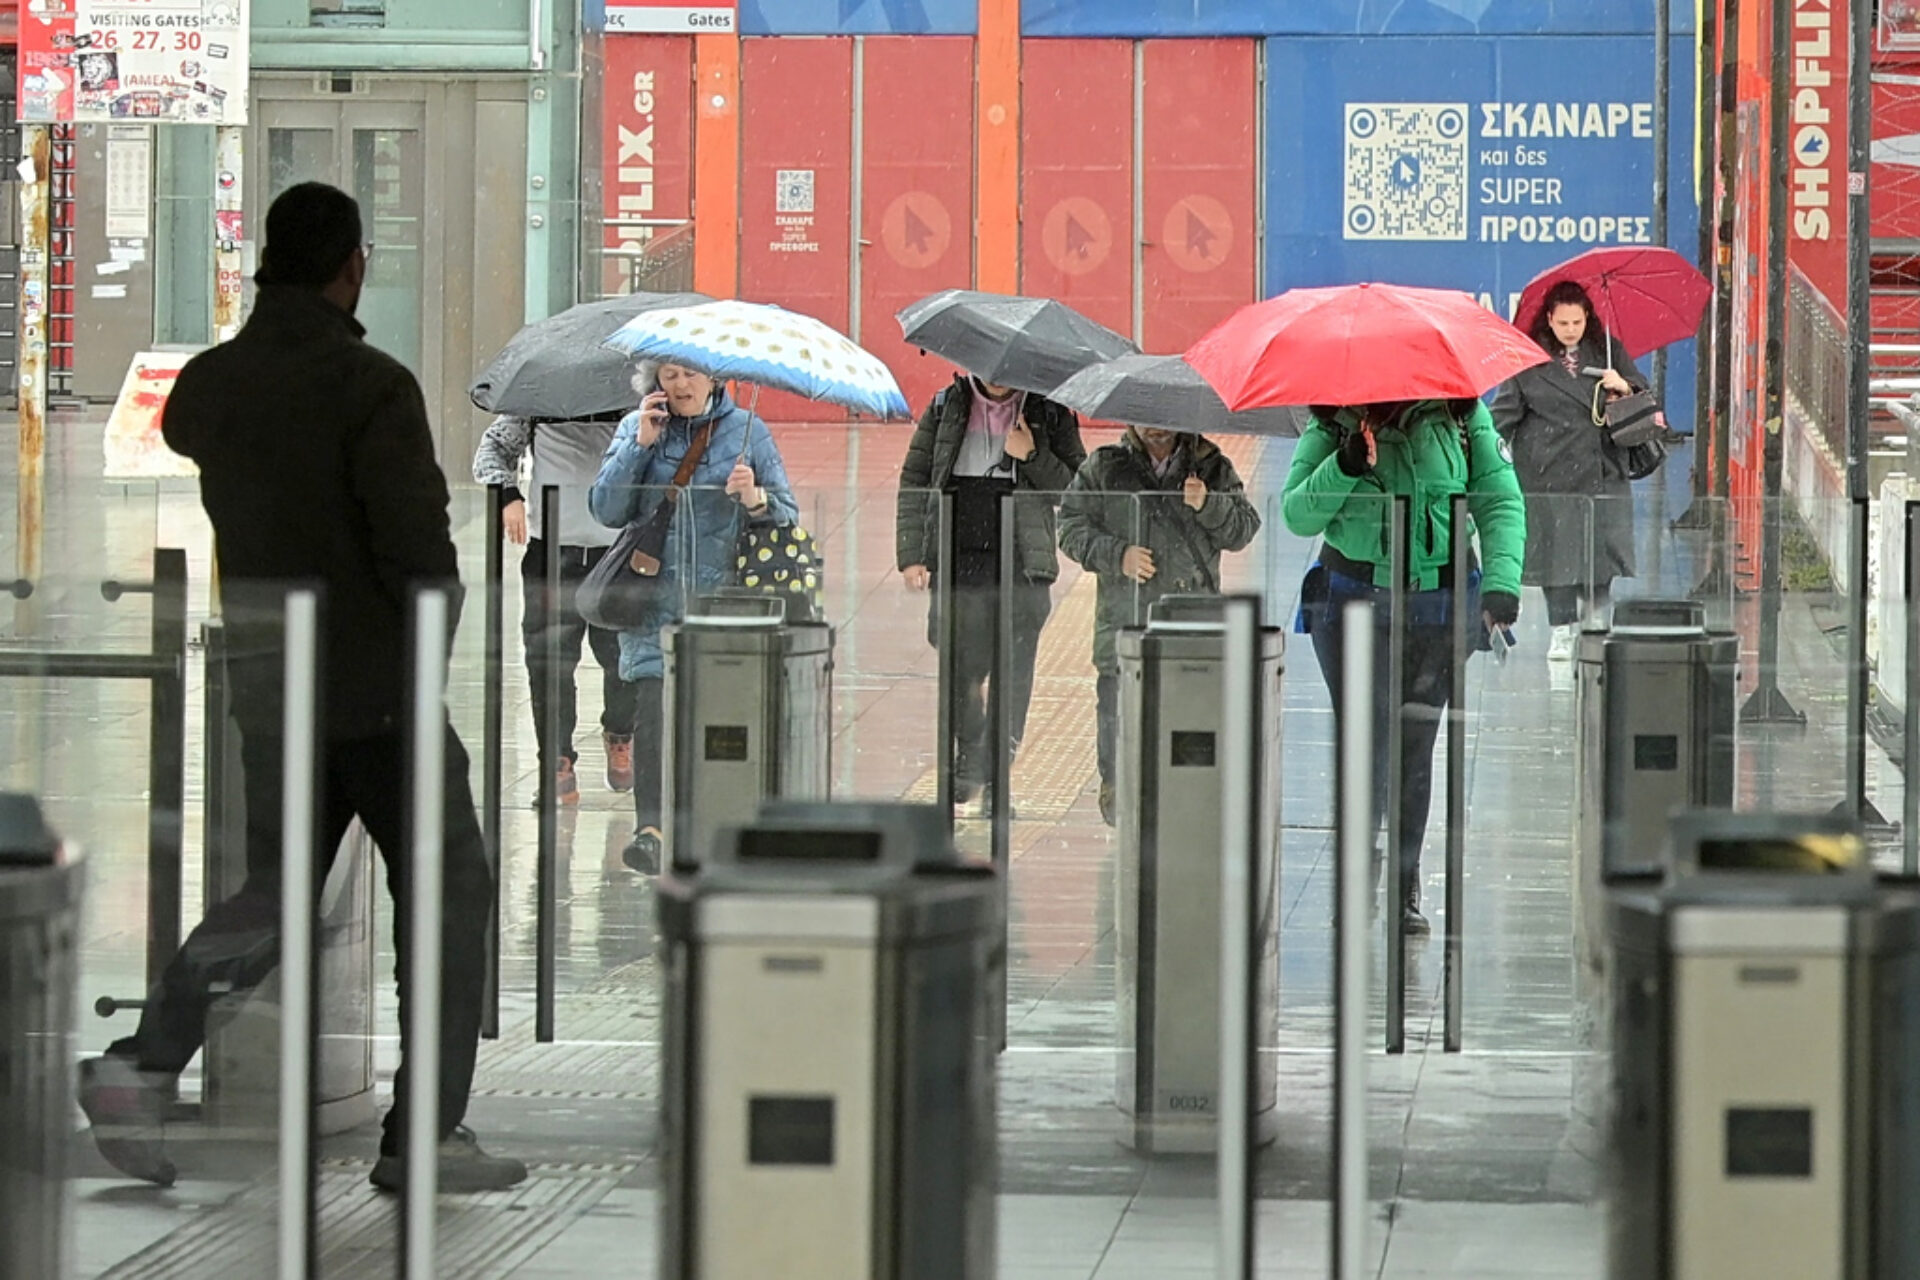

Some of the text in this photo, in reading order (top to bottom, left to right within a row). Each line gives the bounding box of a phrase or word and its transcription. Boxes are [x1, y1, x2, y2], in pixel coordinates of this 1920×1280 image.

[90, 14, 151, 27] VISITING
[155, 14, 200, 27] GATES
[687, 12, 730, 27] Gates
[174, 31, 202, 50] 30
[1480, 102, 1653, 139] ΣΚΑΝΑΡΕ
[1795, 0, 1831, 241] SHOPFLI
[1480, 150, 1508, 166] και
[1480, 178, 1562, 205] SUPER
[1480, 215, 1651, 243] ΠΡΟΣΦΟΡΕΣ
